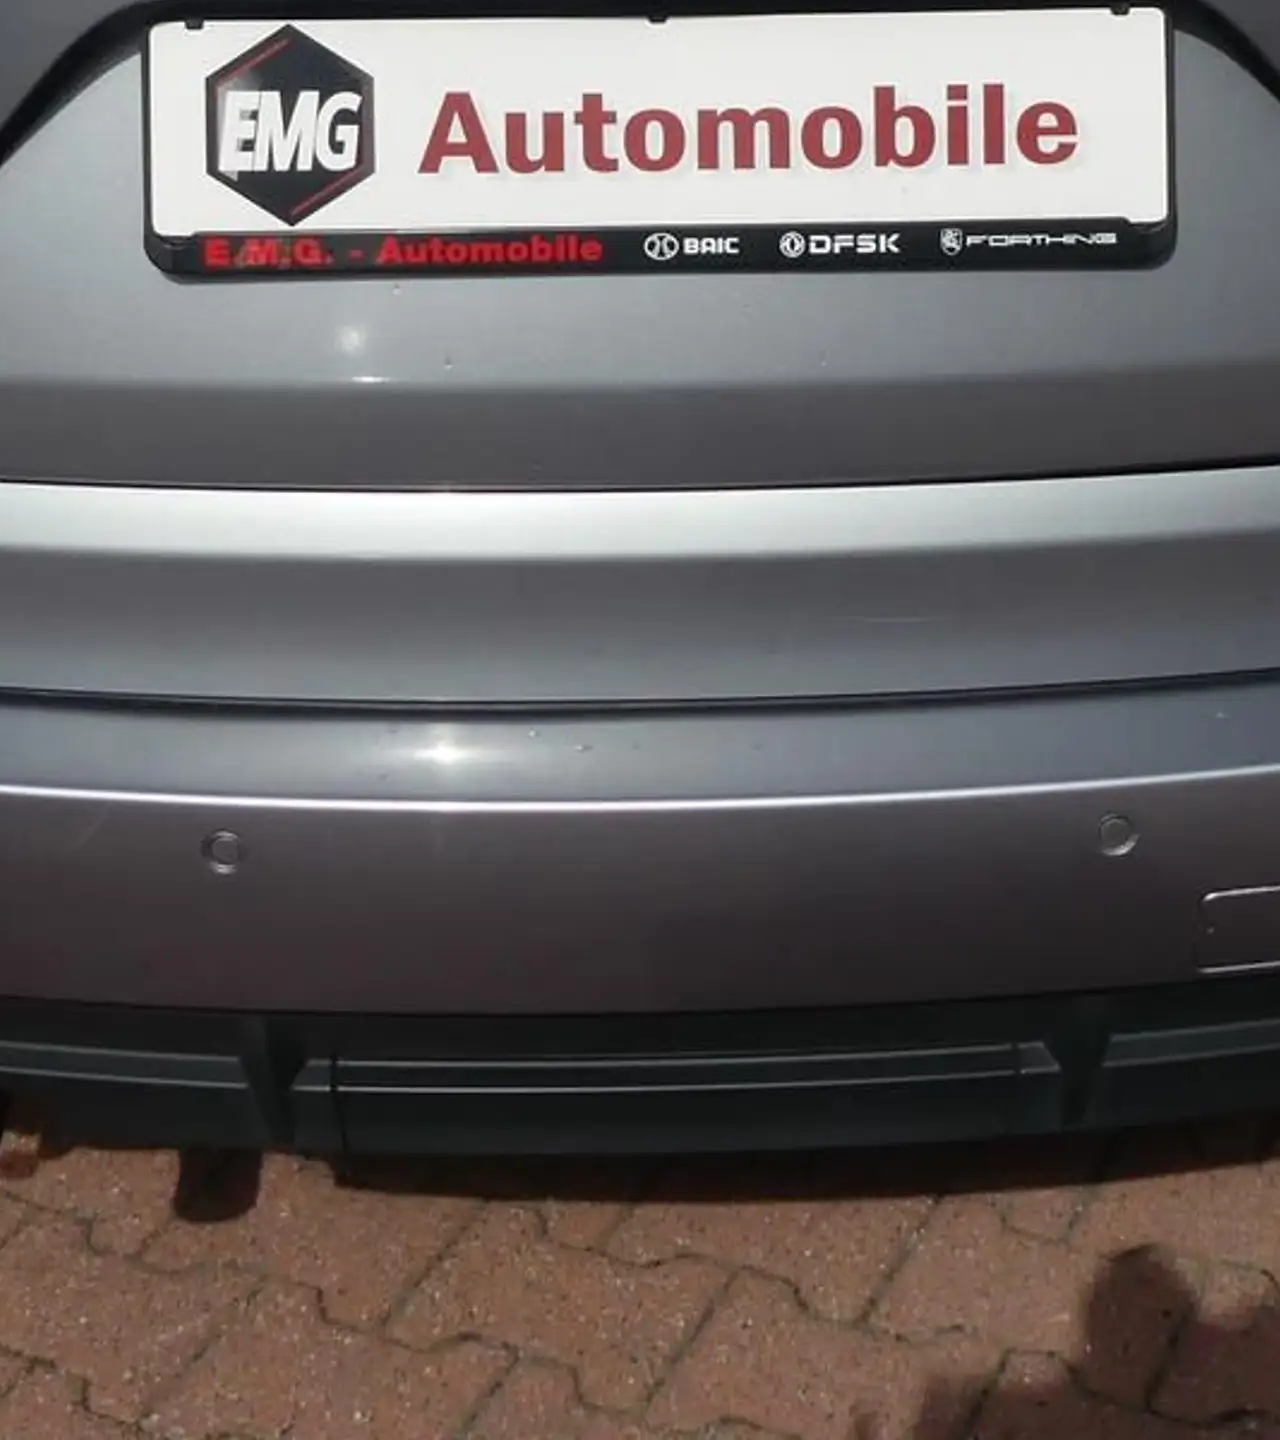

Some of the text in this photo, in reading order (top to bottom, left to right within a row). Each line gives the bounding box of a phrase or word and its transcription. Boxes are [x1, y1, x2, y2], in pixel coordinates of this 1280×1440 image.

[218, 83, 1078, 174] EMG Automobile
[376, 234, 603, 265] Automobile
[683, 237, 740, 255] BAIC
[809, 233, 901, 254] DFSK
